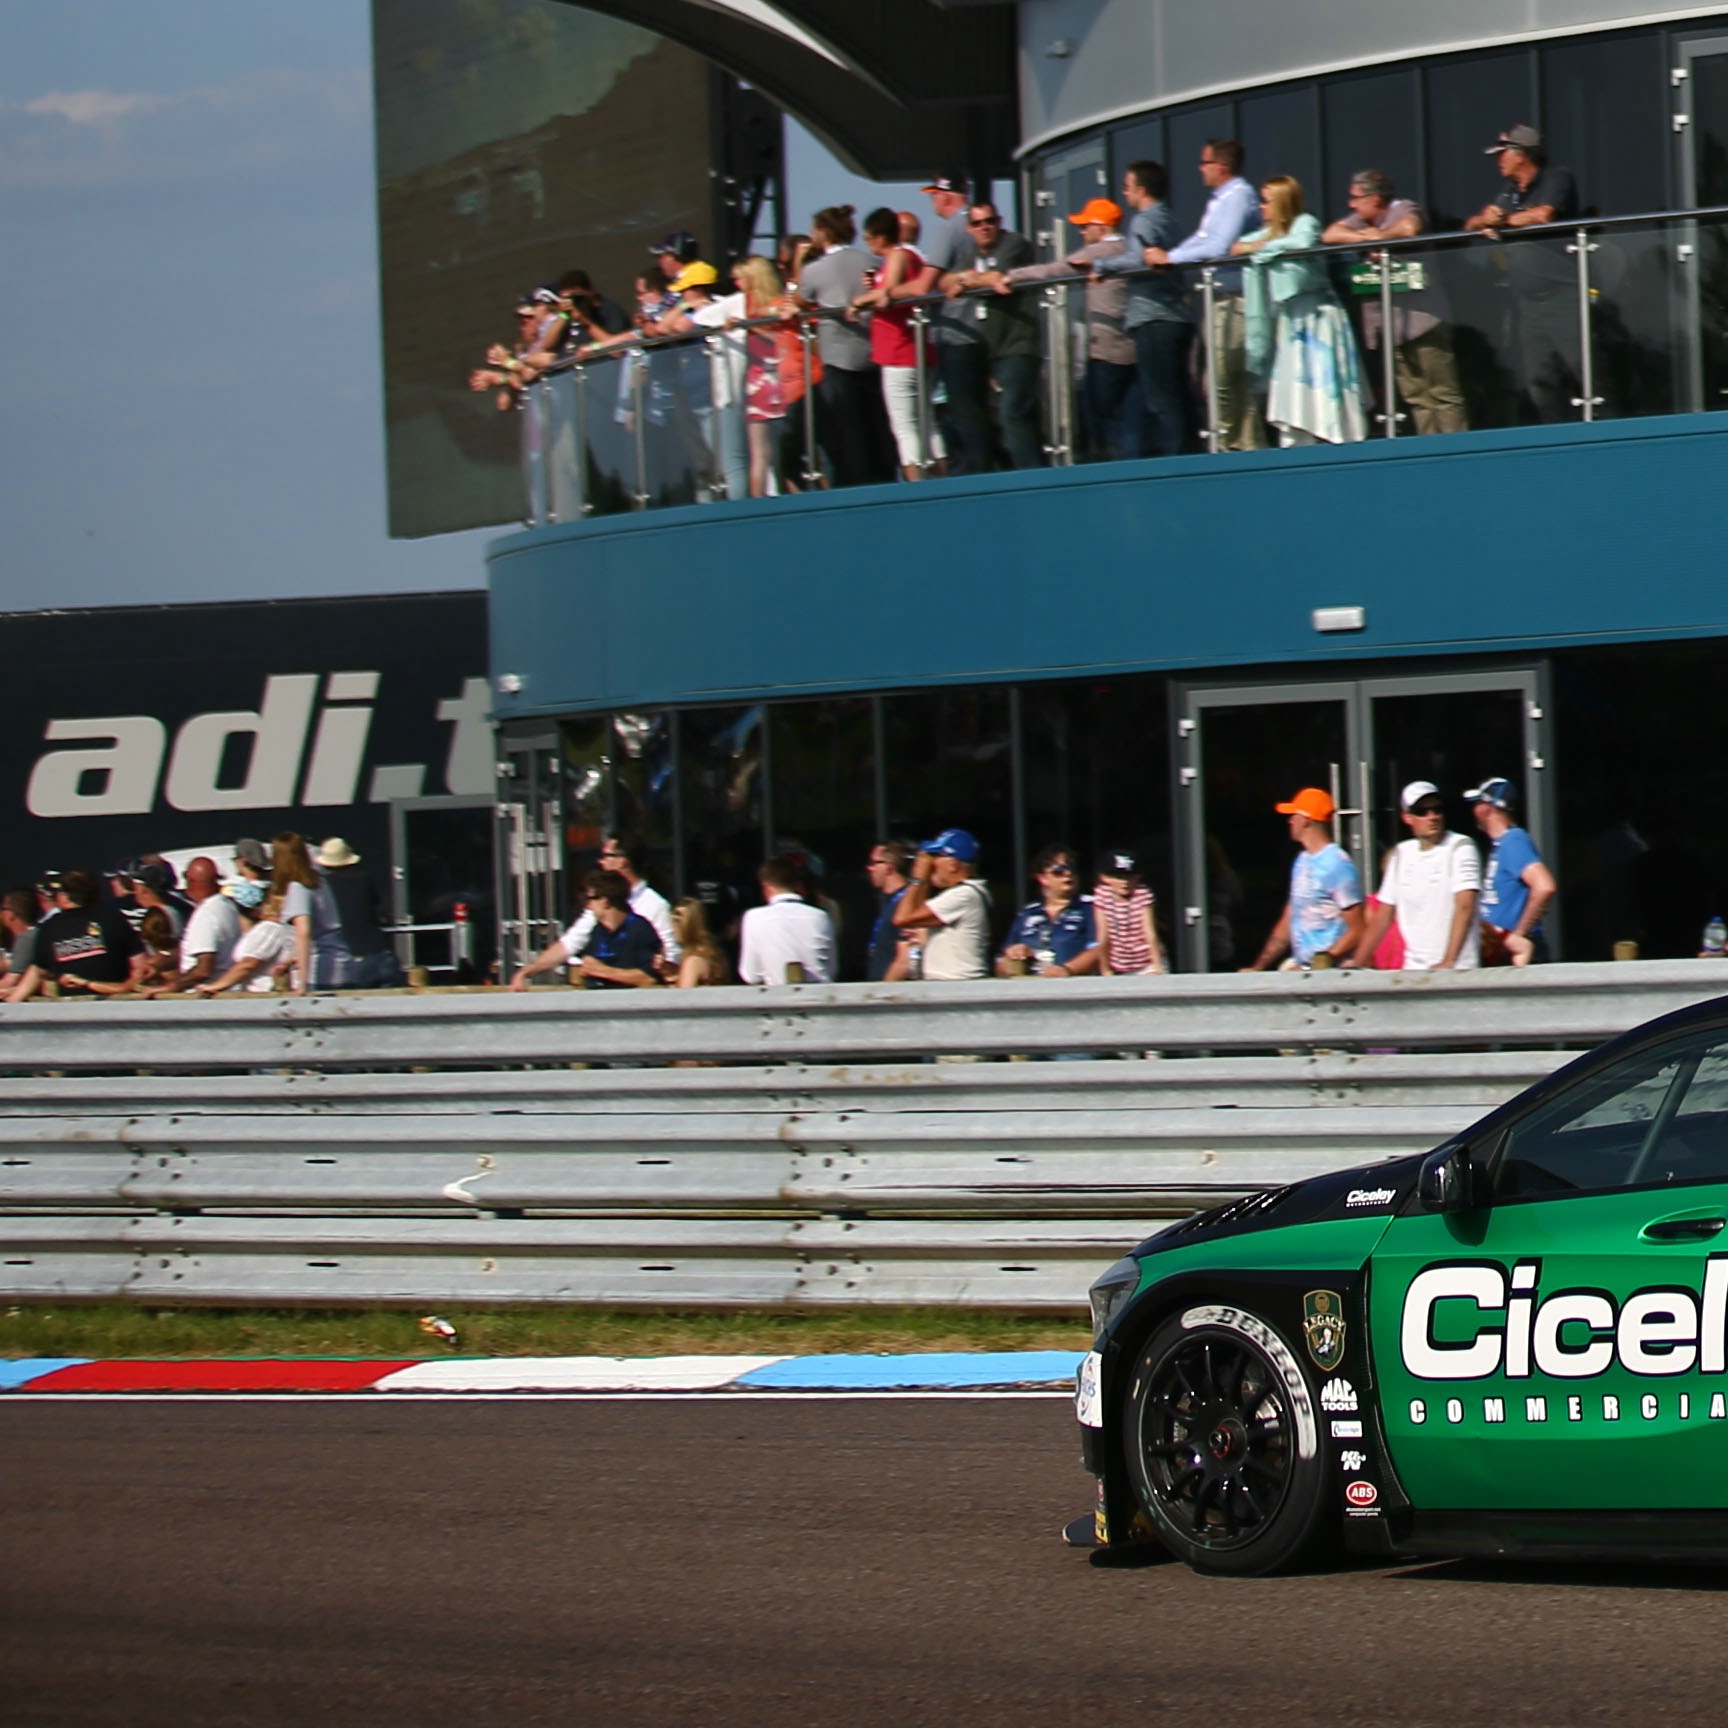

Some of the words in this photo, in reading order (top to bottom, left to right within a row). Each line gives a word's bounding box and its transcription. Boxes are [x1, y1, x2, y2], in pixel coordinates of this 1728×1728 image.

[1320, 1377, 1358, 1402] MAC
[1321, 1402, 1359, 1411] TOOLS
[1351, 1487, 1374, 1498] ABS
